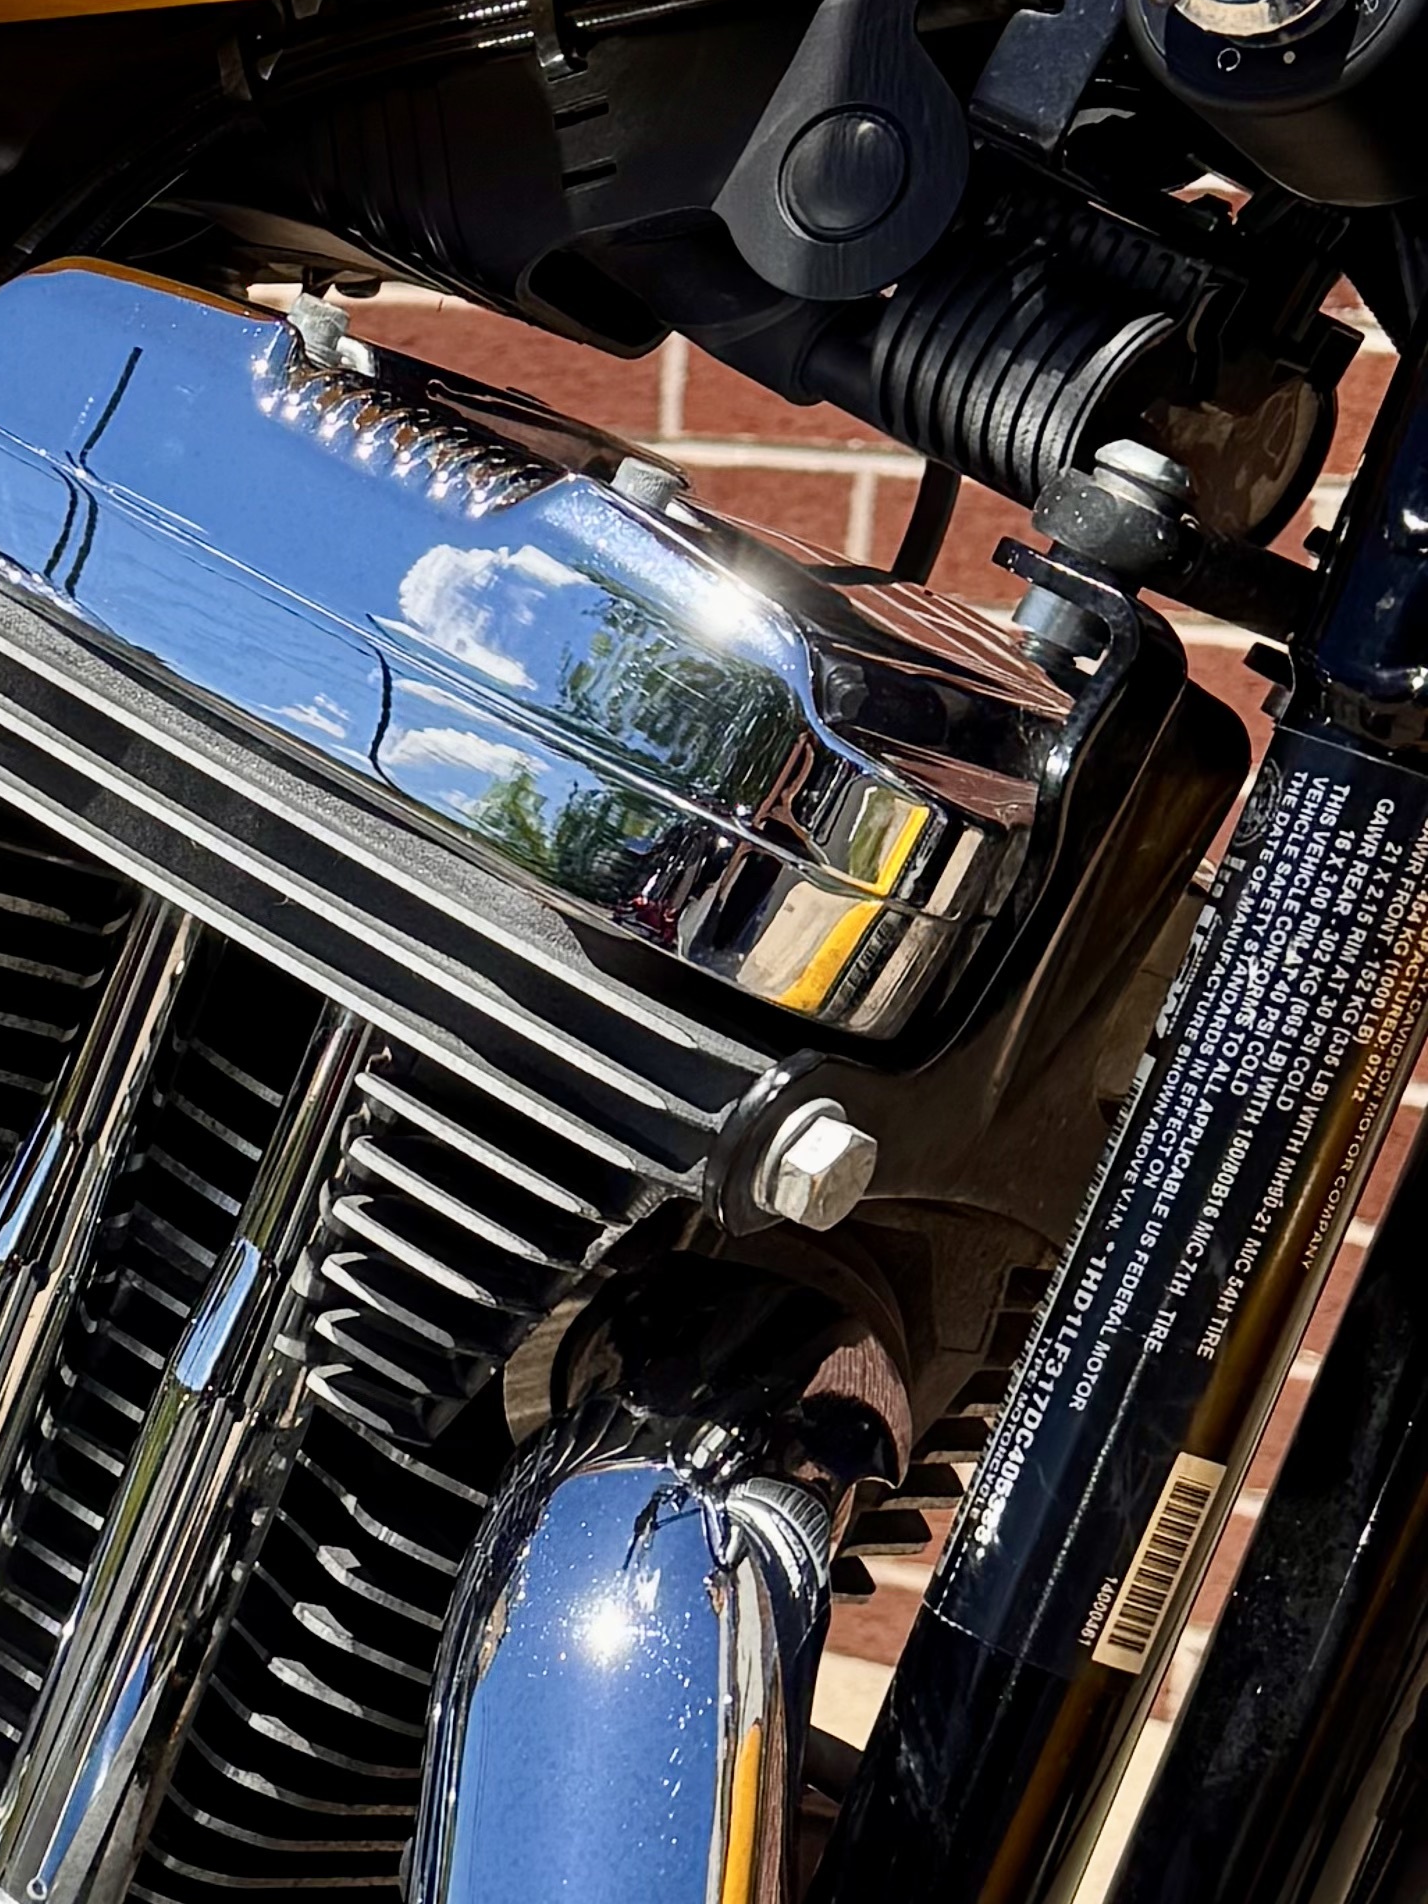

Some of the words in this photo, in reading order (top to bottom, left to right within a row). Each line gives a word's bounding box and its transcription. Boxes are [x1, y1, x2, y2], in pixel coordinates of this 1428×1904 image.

[1282, 772, 1308, 808] THE
[1320, 785, 1350, 826] THIS
[1260, 810, 1290, 863] DATE
[1283, 778, 1329, 859] VEHICLE
[1357, 799, 1394, 858] GAWR
[1335, 831, 1355, 850] 16
[1381, 842, 1402, 863] 21
[1405, 819, 1428, 874] AWR
[1246, 866, 1266, 893] OF
[1283, 832, 1330, 914] VEHICLE
[1326, 852, 1346, 869] X
[1373, 867, 1392, 883] X
[1252, 861, 1292, 937] SAFETY
[1311, 871, 1338, 909] 3.00
[1333, 860, 1369, 915] REAR
[1357, 885, 1384, 924] 2.15
[1291, 912, 1321, 948] RIM
[1377, 878, 1415, 945] FRONT
[1313, 929, 1339, 962] 302
[1339, 927, 1367, 963] RIM
[1394, 927, 1416, 956] KG
[1185, 894, 1255, 1041] MANUFACTURE
[1235, 916, 1292, 1030] CONFORMS
[1281, 947, 1303, 980] AT
[1300, 965, 1324, 995] KG
[1328, 965, 1349, 993] AT
[1356, 961, 1380, 991] 152
[1200, 939, 1259, 1055] STANDARDS
[1270, 980, 1290, 1003] 40
[1371, 960, 1402, 1009] (1000
[1374, 920, 1428, 1049] UFACTURED:
[1254, 1006, 1280, 1038] PSI
[1317, 995, 1337, 1018] 30
[1342, 995, 1365, 1024] KG
[1222, 1032, 1245, 1057] TO
[1300, 1021, 1327, 1054] PSI
[1353, 1013, 1379, 1044] LB)
[1189, 1059, 1209, 1079] IN
[1230, 1041, 1264, 1095] COLD
[1262, 1040, 1292, 1072] LB)
[1153, 1044, 1191, 1115] SHOWN
[1203, 1059, 1230, 1094] ALL
[1277, 1057, 1310, 1111] COLD
[1305, 1070, 1334, 1101] LB)
[1351, 1054, 1381, 1101] 07/12
[1158, 1082, 1198, 1157] EFFECT
[1243, 1076, 1278, 1124] WITH
[1286, 1106, 1319, 1153] WITH
[1341, 1102, 1378, 1171] MOTOR
[1124, 1118, 1159, 1184] ABOVE
[1152, 1098, 1213, 1218] APPLICABLE
[1143, 1159, 1164, 1188] ON
[1203, 1130, 1253, 1218] 150/80B16
[1105, 1189, 1135, 1230] V.I.N.
[1252, 1157, 1296, 1232] MH90-21
[1140, 1221, 1162, 1247] US
[1186, 1220, 1214, 1257] M/C
[1302, 1176, 1345, 1269] COMPANY
[1235, 1238, 1261, 1273] M/C
[1100, 1250, 1149, 1335] FEDERAL
[1167, 1260, 1197, 1296] 71H
[1217, 1276, 1244, 1312] 54H
[1144, 1310, 1176, 1352] TIRE
[1197, 1318, 1228, 1359] TIRE
[1069, 1341, 1110, 1411] MOTOR
